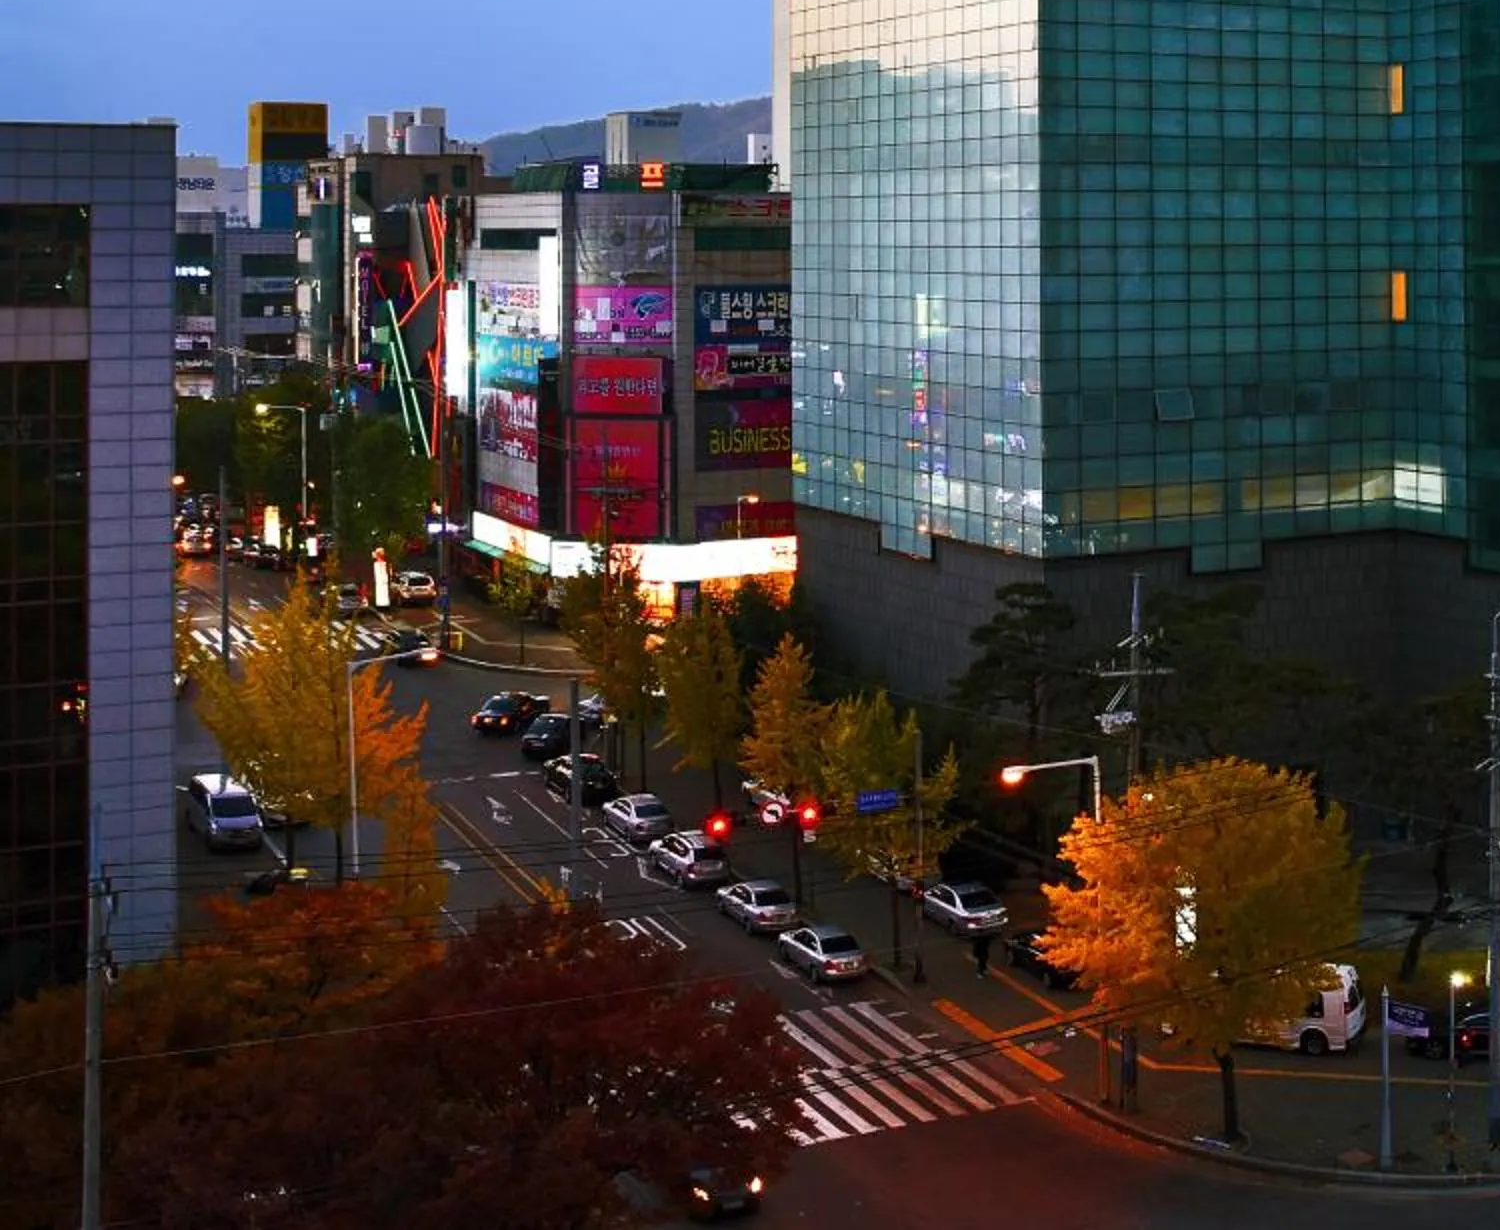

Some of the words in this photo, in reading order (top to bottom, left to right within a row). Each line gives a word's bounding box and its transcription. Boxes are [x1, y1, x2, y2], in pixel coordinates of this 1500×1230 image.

[360, 267, 369, 331] MOTEL
[756, 291, 789, 319] 스크린
[709, 426, 791, 454] BUSINESS
